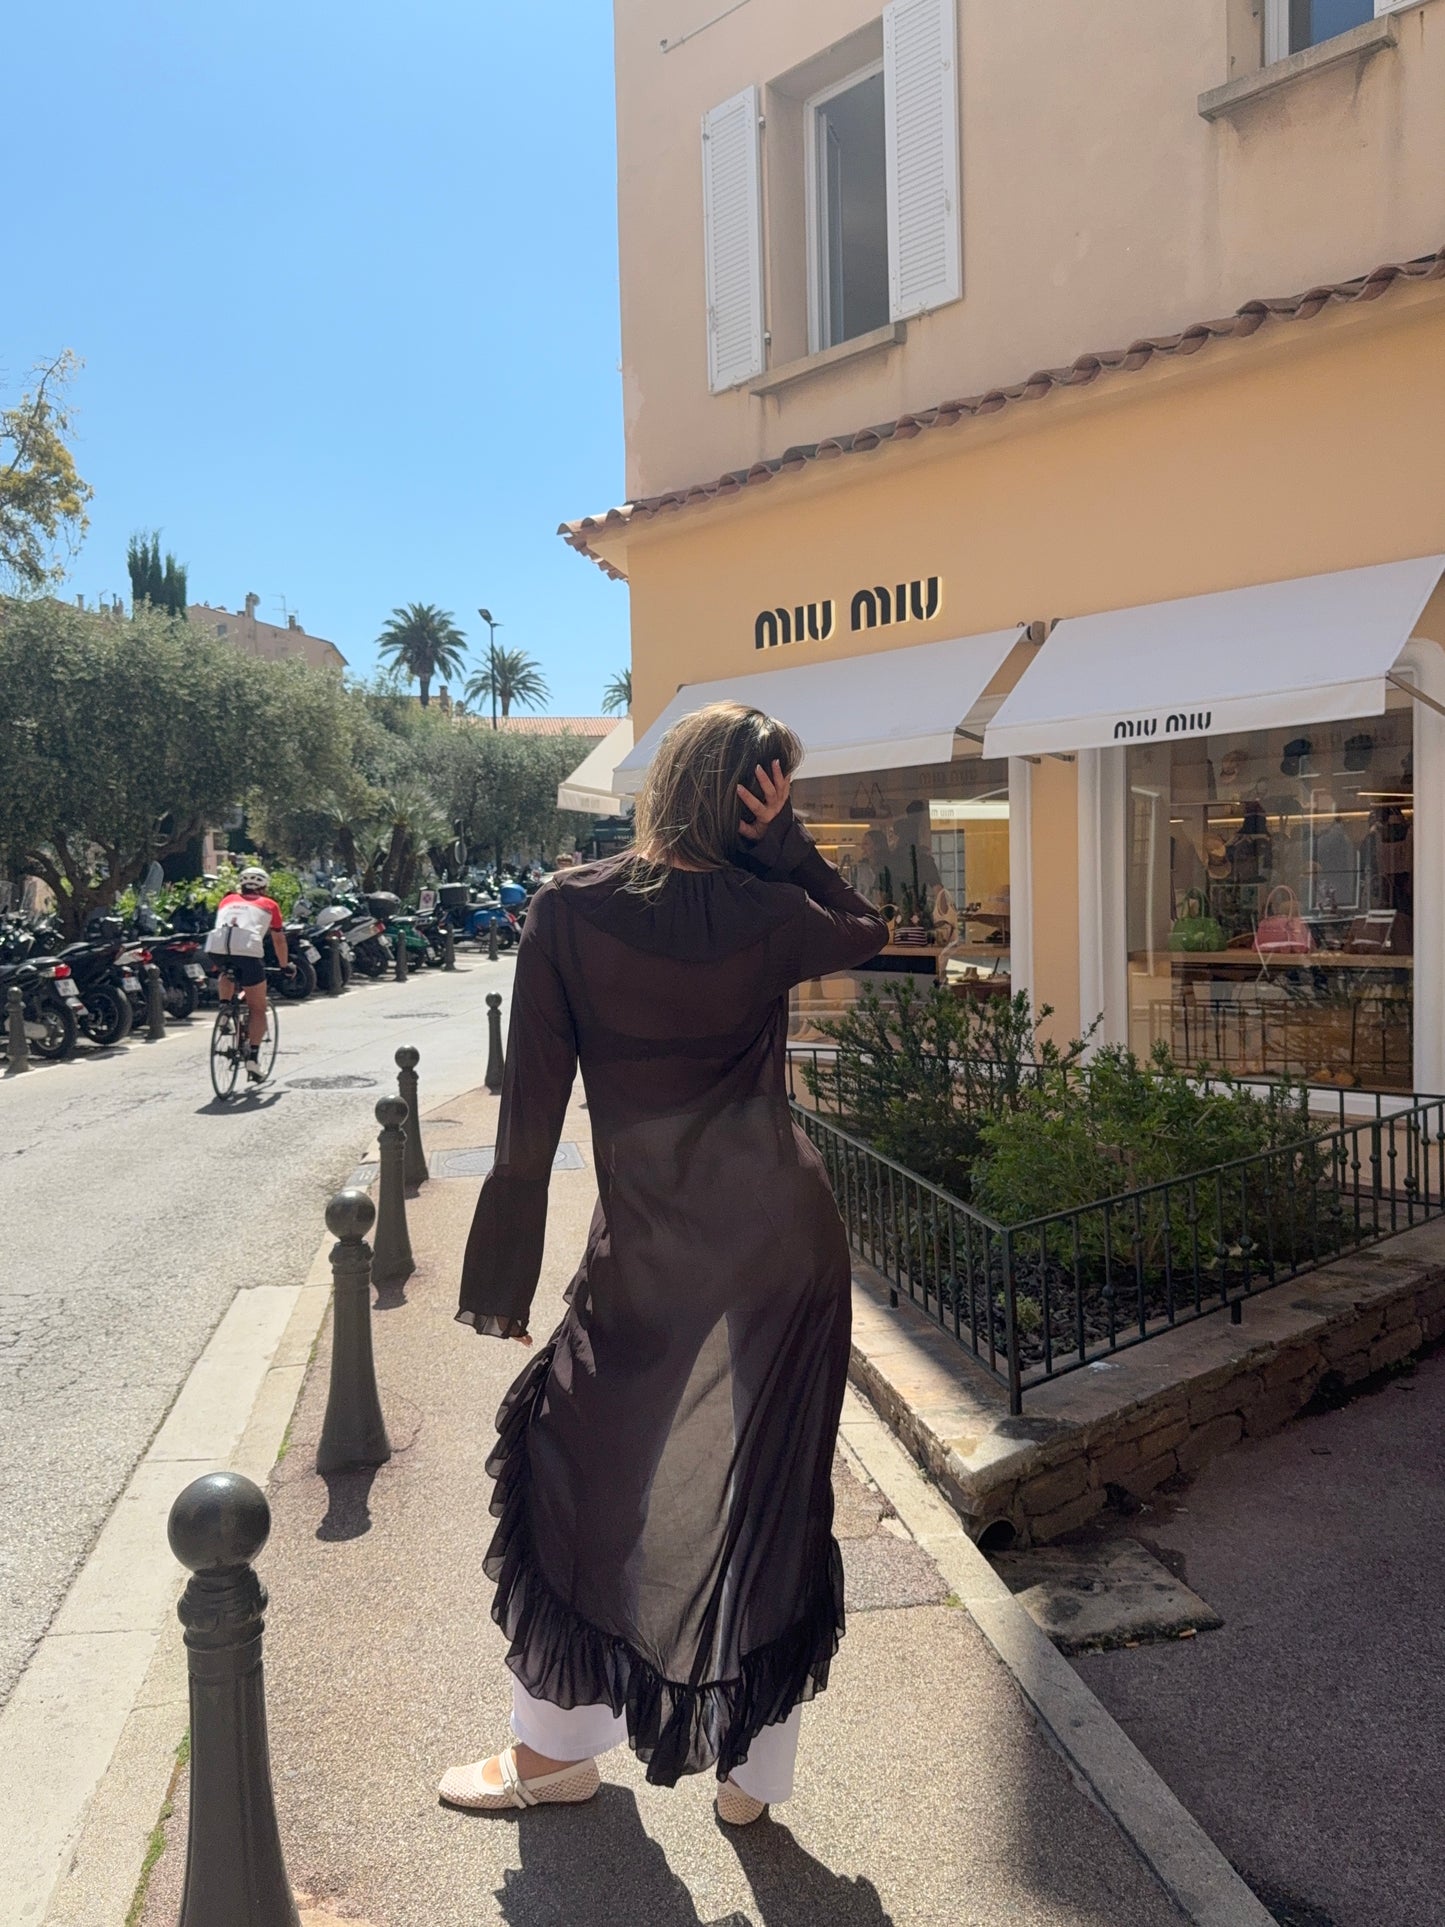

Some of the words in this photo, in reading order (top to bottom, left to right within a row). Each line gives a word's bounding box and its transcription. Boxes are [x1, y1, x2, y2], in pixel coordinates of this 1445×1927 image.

[755, 600, 834, 650] MIU
[851, 576, 941, 631] MIU
[1114, 718, 1157, 739] MIU
[1165, 711, 1212, 733] MIU
